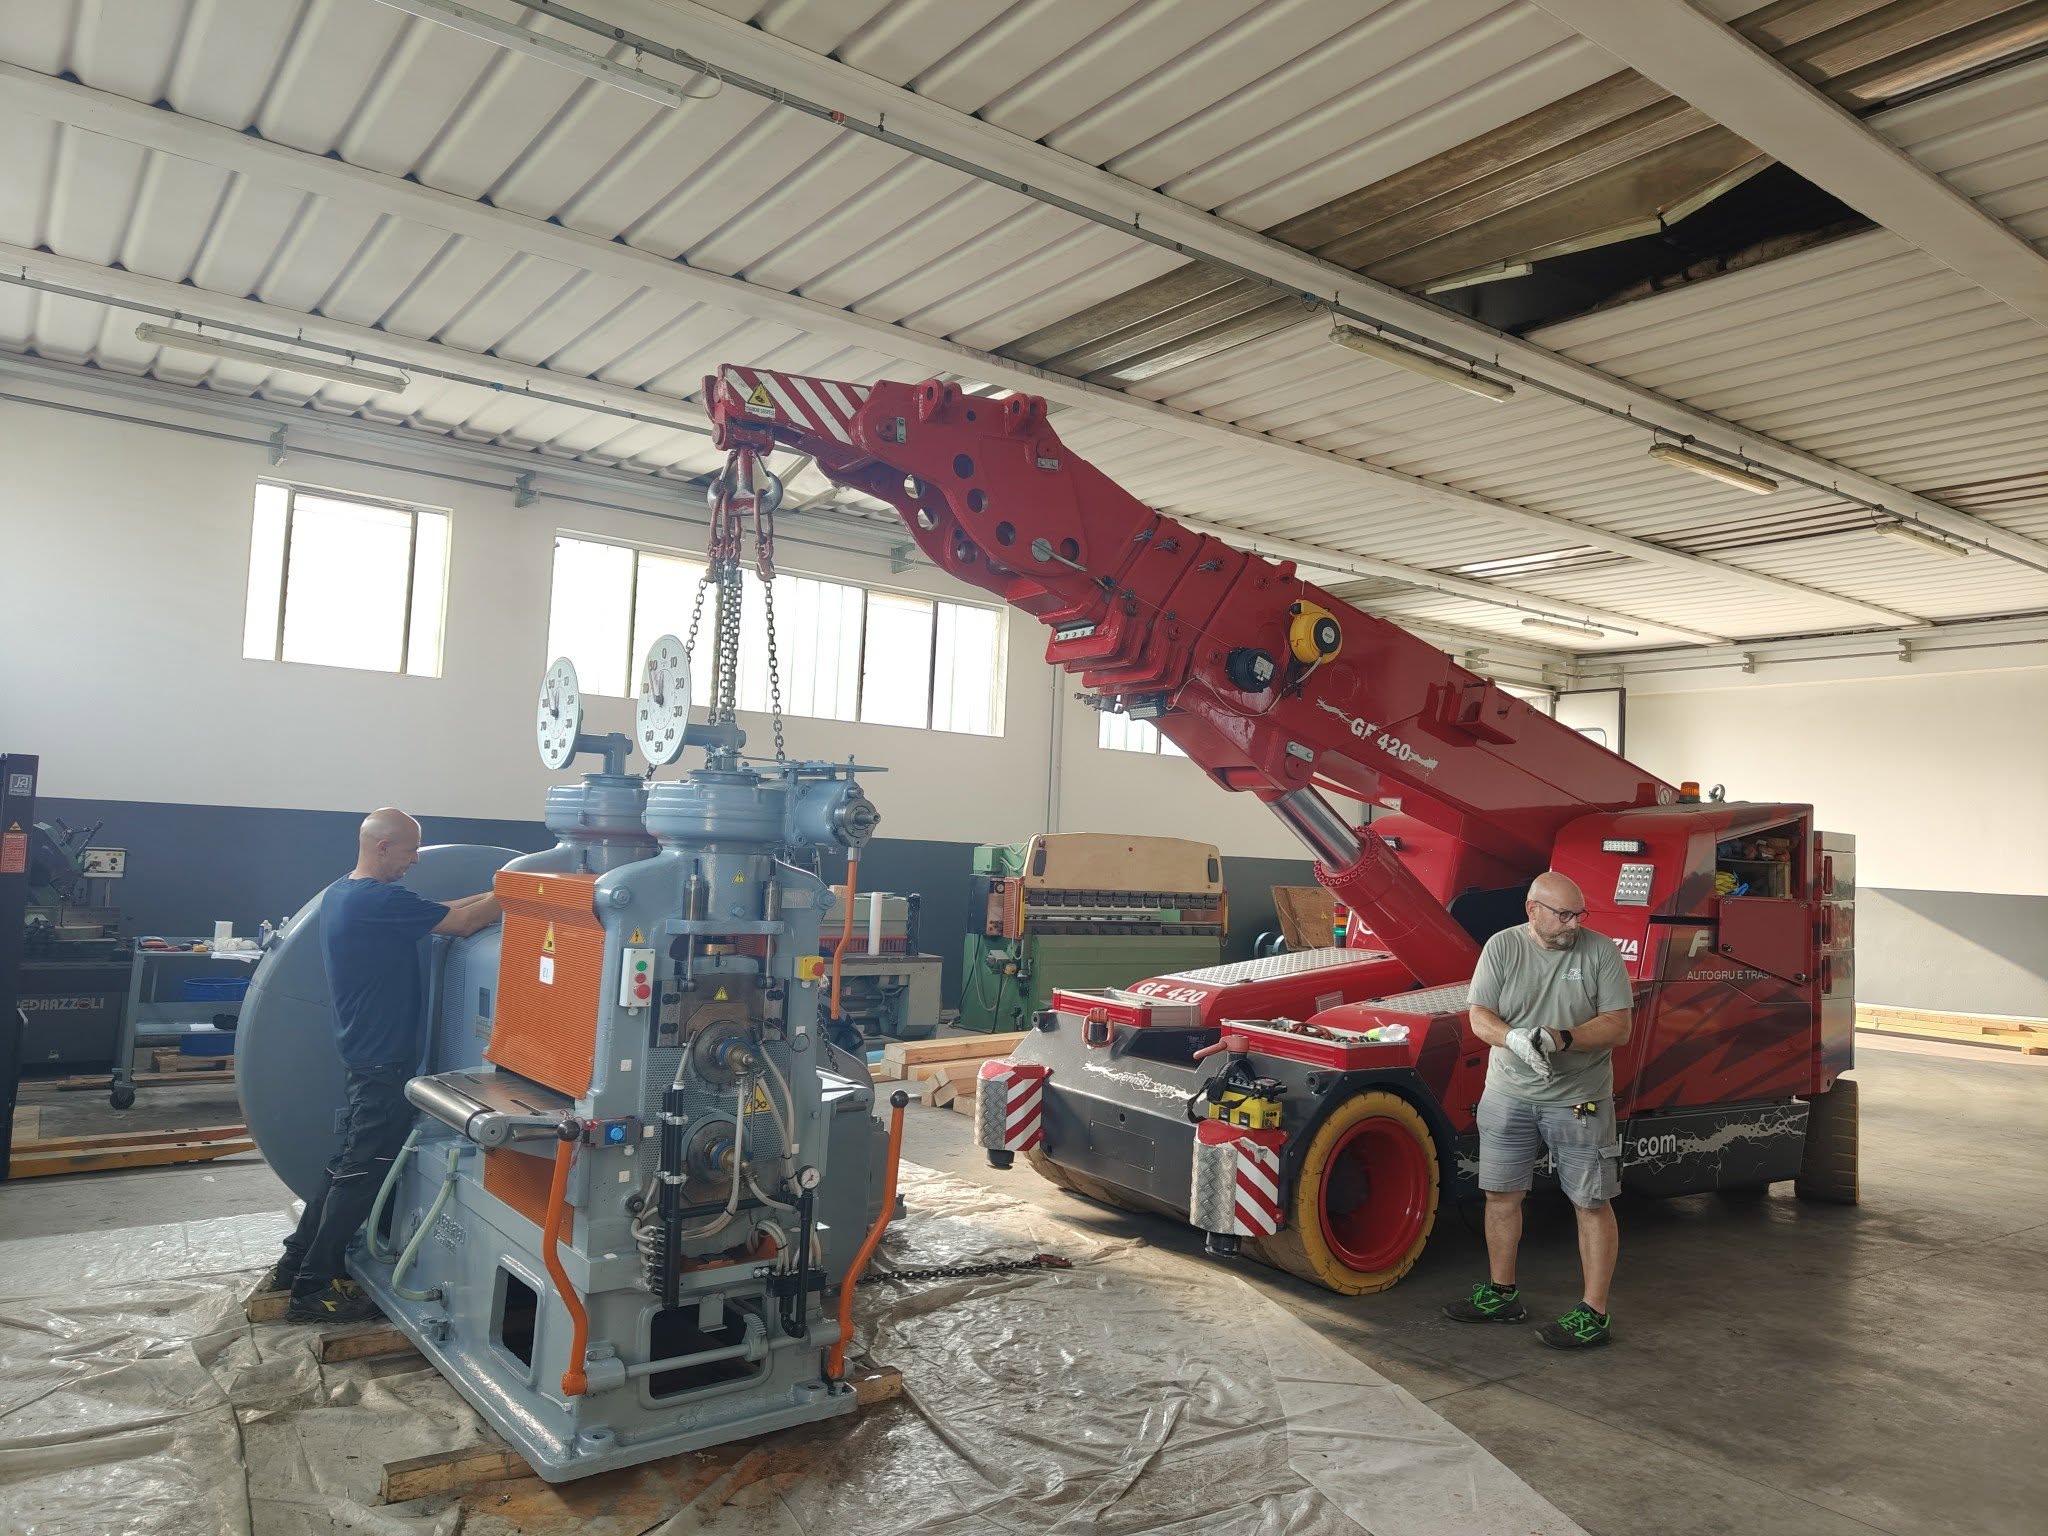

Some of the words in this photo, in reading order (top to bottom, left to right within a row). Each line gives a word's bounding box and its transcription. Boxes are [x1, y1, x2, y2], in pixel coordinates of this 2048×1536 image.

[662, 648, 667, 659] 0
[670, 656, 677, 668] 10
[563, 676, 569, 687] 10
[675, 677, 684, 689] 20
[567, 694, 574, 705] 20
[641, 709, 648, 721] 70
[673, 705, 682, 718] 30
[541, 721, 547, 731] 70
[565, 718, 572, 728] 30
[645, 730, 654, 742] 60
[664, 728, 674, 740] 40
[1351, 717, 1377, 740] GF
[1377, 733, 1411, 761] 420
[544, 739, 551, 749] 60
[558, 738, 566, 749] 40
[654, 741, 663, 752] 50
[551, 749, 558, 759] 50
[1687, 970, 1735, 981] AUTOGRU
[1737, 970, 1744, 980] E
[1745, 970, 1772, 980] TRAS
[1136, 982, 1171, 996] GF
[1166, 987, 1208, 1003] 420
